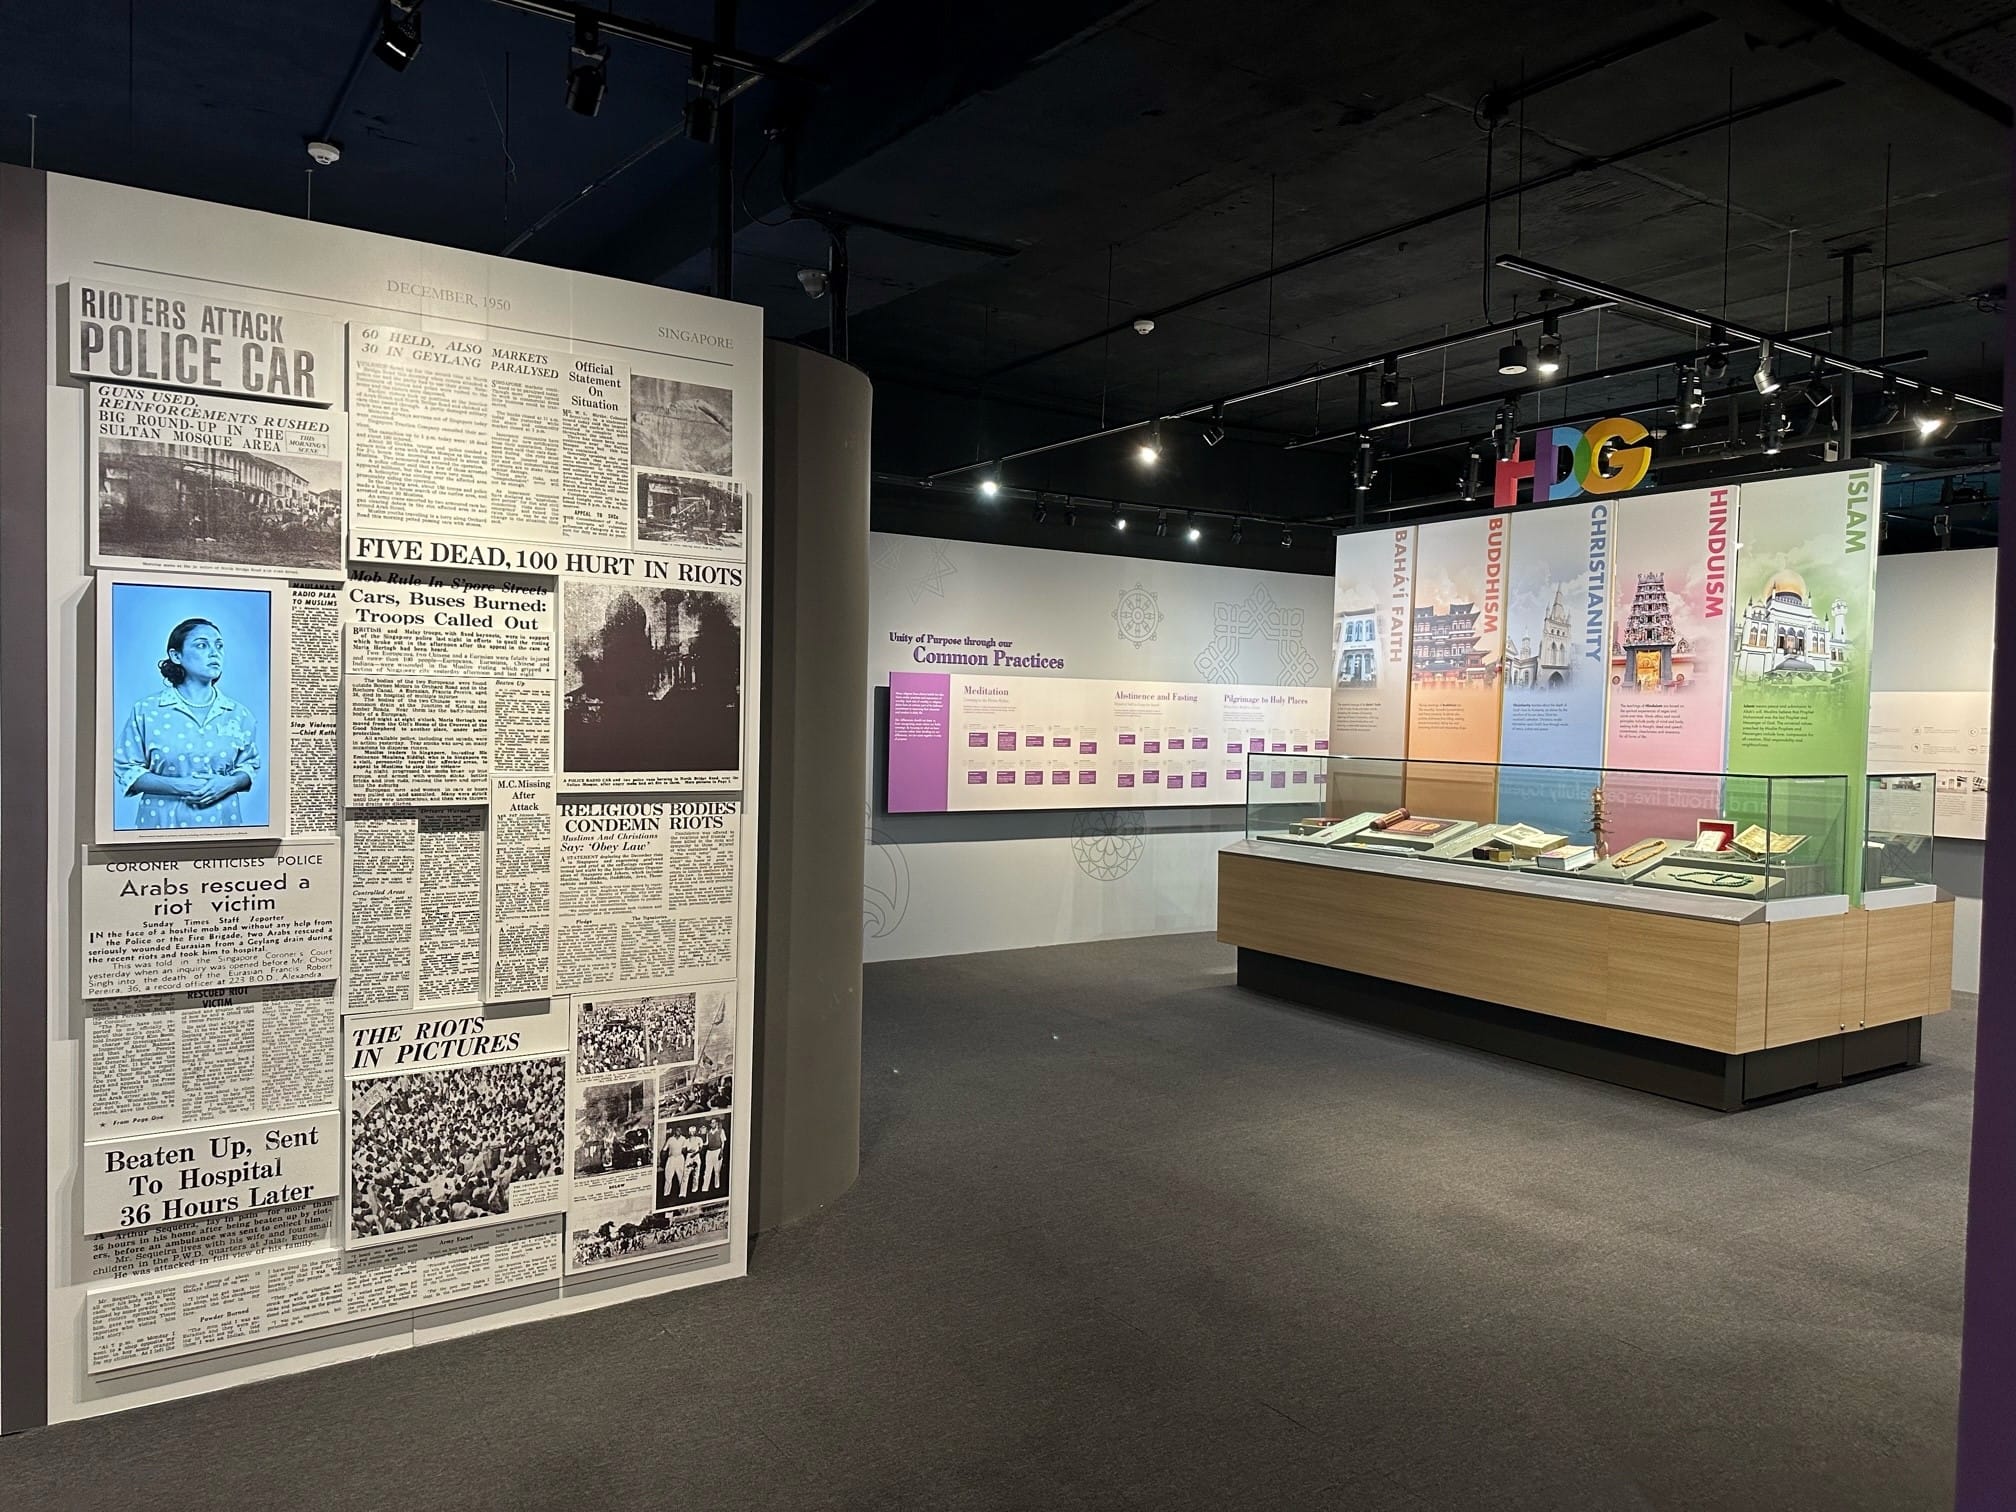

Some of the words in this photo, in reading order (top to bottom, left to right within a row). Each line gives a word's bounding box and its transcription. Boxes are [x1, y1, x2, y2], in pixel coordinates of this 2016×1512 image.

[387, 280, 478, 307] DECEMBER,
[483, 292, 511, 311] 1950
[81, 288, 185, 329] RIOTERS
[202, 305, 283, 343] ATTACK
[362, 329, 378, 340] 60
[390, 332, 434, 348] HELD,
[446, 340, 482, 354] ALSO
[658, 326, 733, 349] SINGAPORE
[81, 321, 221, 387] POLICE
[242, 343, 315, 398] CAR
[362, 344, 377, 354] 30
[386, 346, 403, 357] IN
[412, 349, 481, 368] GEYLANG
[492, 349, 548, 364] MARKETS
[490, 361, 559, 379] PARALYSED
[569, 372, 621, 387] Statement
[575, 361, 614, 376] Official
[98, 386, 144, 400] GUNS
[588, 386, 603, 397] On
[99, 398, 258, 424] REINFORCEMENTS
[264, 416, 330, 432] RUSHED
[572, 396, 618, 411] Situation
[99, 410, 124, 423] BIG
[137, 414, 216, 433] ROUND-UP
[227, 424, 242, 436] IN
[255, 428, 284, 440] THE
[100, 424, 160, 439] SULTAN
[173, 431, 232, 448] MOSQUE
[243, 439, 281, 452] AREA
[1845, 472, 1869, 554] ISLAM
[357, 538, 422, 560] FIVE
[516, 550, 558, 570] 100
[566, 554, 634, 576] HURT
[644, 561, 669, 578] IN
[679, 562, 742, 587] RIOTS
[1705, 488, 1728, 618] HINDUISM
[351, 570, 382, 583] Mob
[388, 573, 421, 587] Rule
[429, 577, 443, 588] In
[451, 578, 495, 593] S'pore
[502, 582, 548, 595] Streets
[1484, 517, 1503, 634] BUDDHISM
[1586, 504, 1607, 662] CHRISTIANITY
[350, 588, 400, 607] Cars,
[409, 592, 465, 608] Buses
[474, 596, 547, 612] Burned:
[356, 608, 424, 626] Troops
[435, 612, 492, 628] Called
[504, 616, 538, 630] Out
[889, 632, 913, 644] Unity
[915, 634, 925, 643] of
[927, 634, 961, 648] Purpose
[964, 636, 996, 648] through
[999, 640, 1012, 648] our
[1390, 606, 1405, 662] FAITH
[913, 646, 988, 666] Common
[993, 650, 1064, 669] Practices
[964, 685, 1009, 696] Meditation
[1114, 691, 1155, 701] Abstinence
[1157, 692, 1170, 701] and
[1172, 693, 1198, 702] Fasting
[1224, 694, 1259, 704] Pilgrimage
[1262, 696, 1268, 704] to
[1270, 696, 1286, 705] Holy
[1288, 696, 1308, 704] Places
[510, 803, 539, 811] Attack
[561, 803, 663, 816] RELIGIOUS
[670, 802, 736, 816] BODIES
[566, 818, 660, 832] CONDEMN
[670, 816, 723, 829] RIOTS
[560, 843, 583, 853] Say:
[561, 834, 594, 842] Muslims
[106, 861, 179, 872] CORONER
[193, 857, 264, 870] CRITICISES
[277, 855, 323, 866] POLICE
[120, 878, 189, 897] Arabs
[201, 873, 287, 894] rescued
[298, 876, 310, 889] a
[154, 899, 193, 916] riot
[211, 895, 275, 913] victim
[90, 932, 103, 943] IN
[294, 920, 311, 928] help
[143, 921, 173, 929] Sunday
[188, 989, 226, 999] RESCUED
[229, 987, 248, 997] RIOT
[202, 999, 232, 1008] VICTIM
[353, 1025, 402, 1047] THE
[416, 1017, 485, 1039] RIOTS
[352, 1046, 383, 1069] IN
[396, 1032, 520, 1064] PICTURES
[105, 1146, 195, 1173] Beaten
[209, 1137, 252, 1159] Up,
[265, 1127, 319, 1151] Sent
[129, 1175, 163, 1197] To
[178, 1157, 282, 1190] Hospital
[120, 1203, 151, 1227] 36
[162, 1195, 239, 1220] Hours
[248, 1184, 314, 1207] Later
[108, 1241, 136, 1249] hours
[154, 1235, 167, 1243] his
[171, 1230, 196, 1239] home
[200, 1226, 224, 1234] after
[226, 1220, 250, 1230] being
[254, 1216, 282, 1225] beaten
[301, 1210, 309, 1218] by
